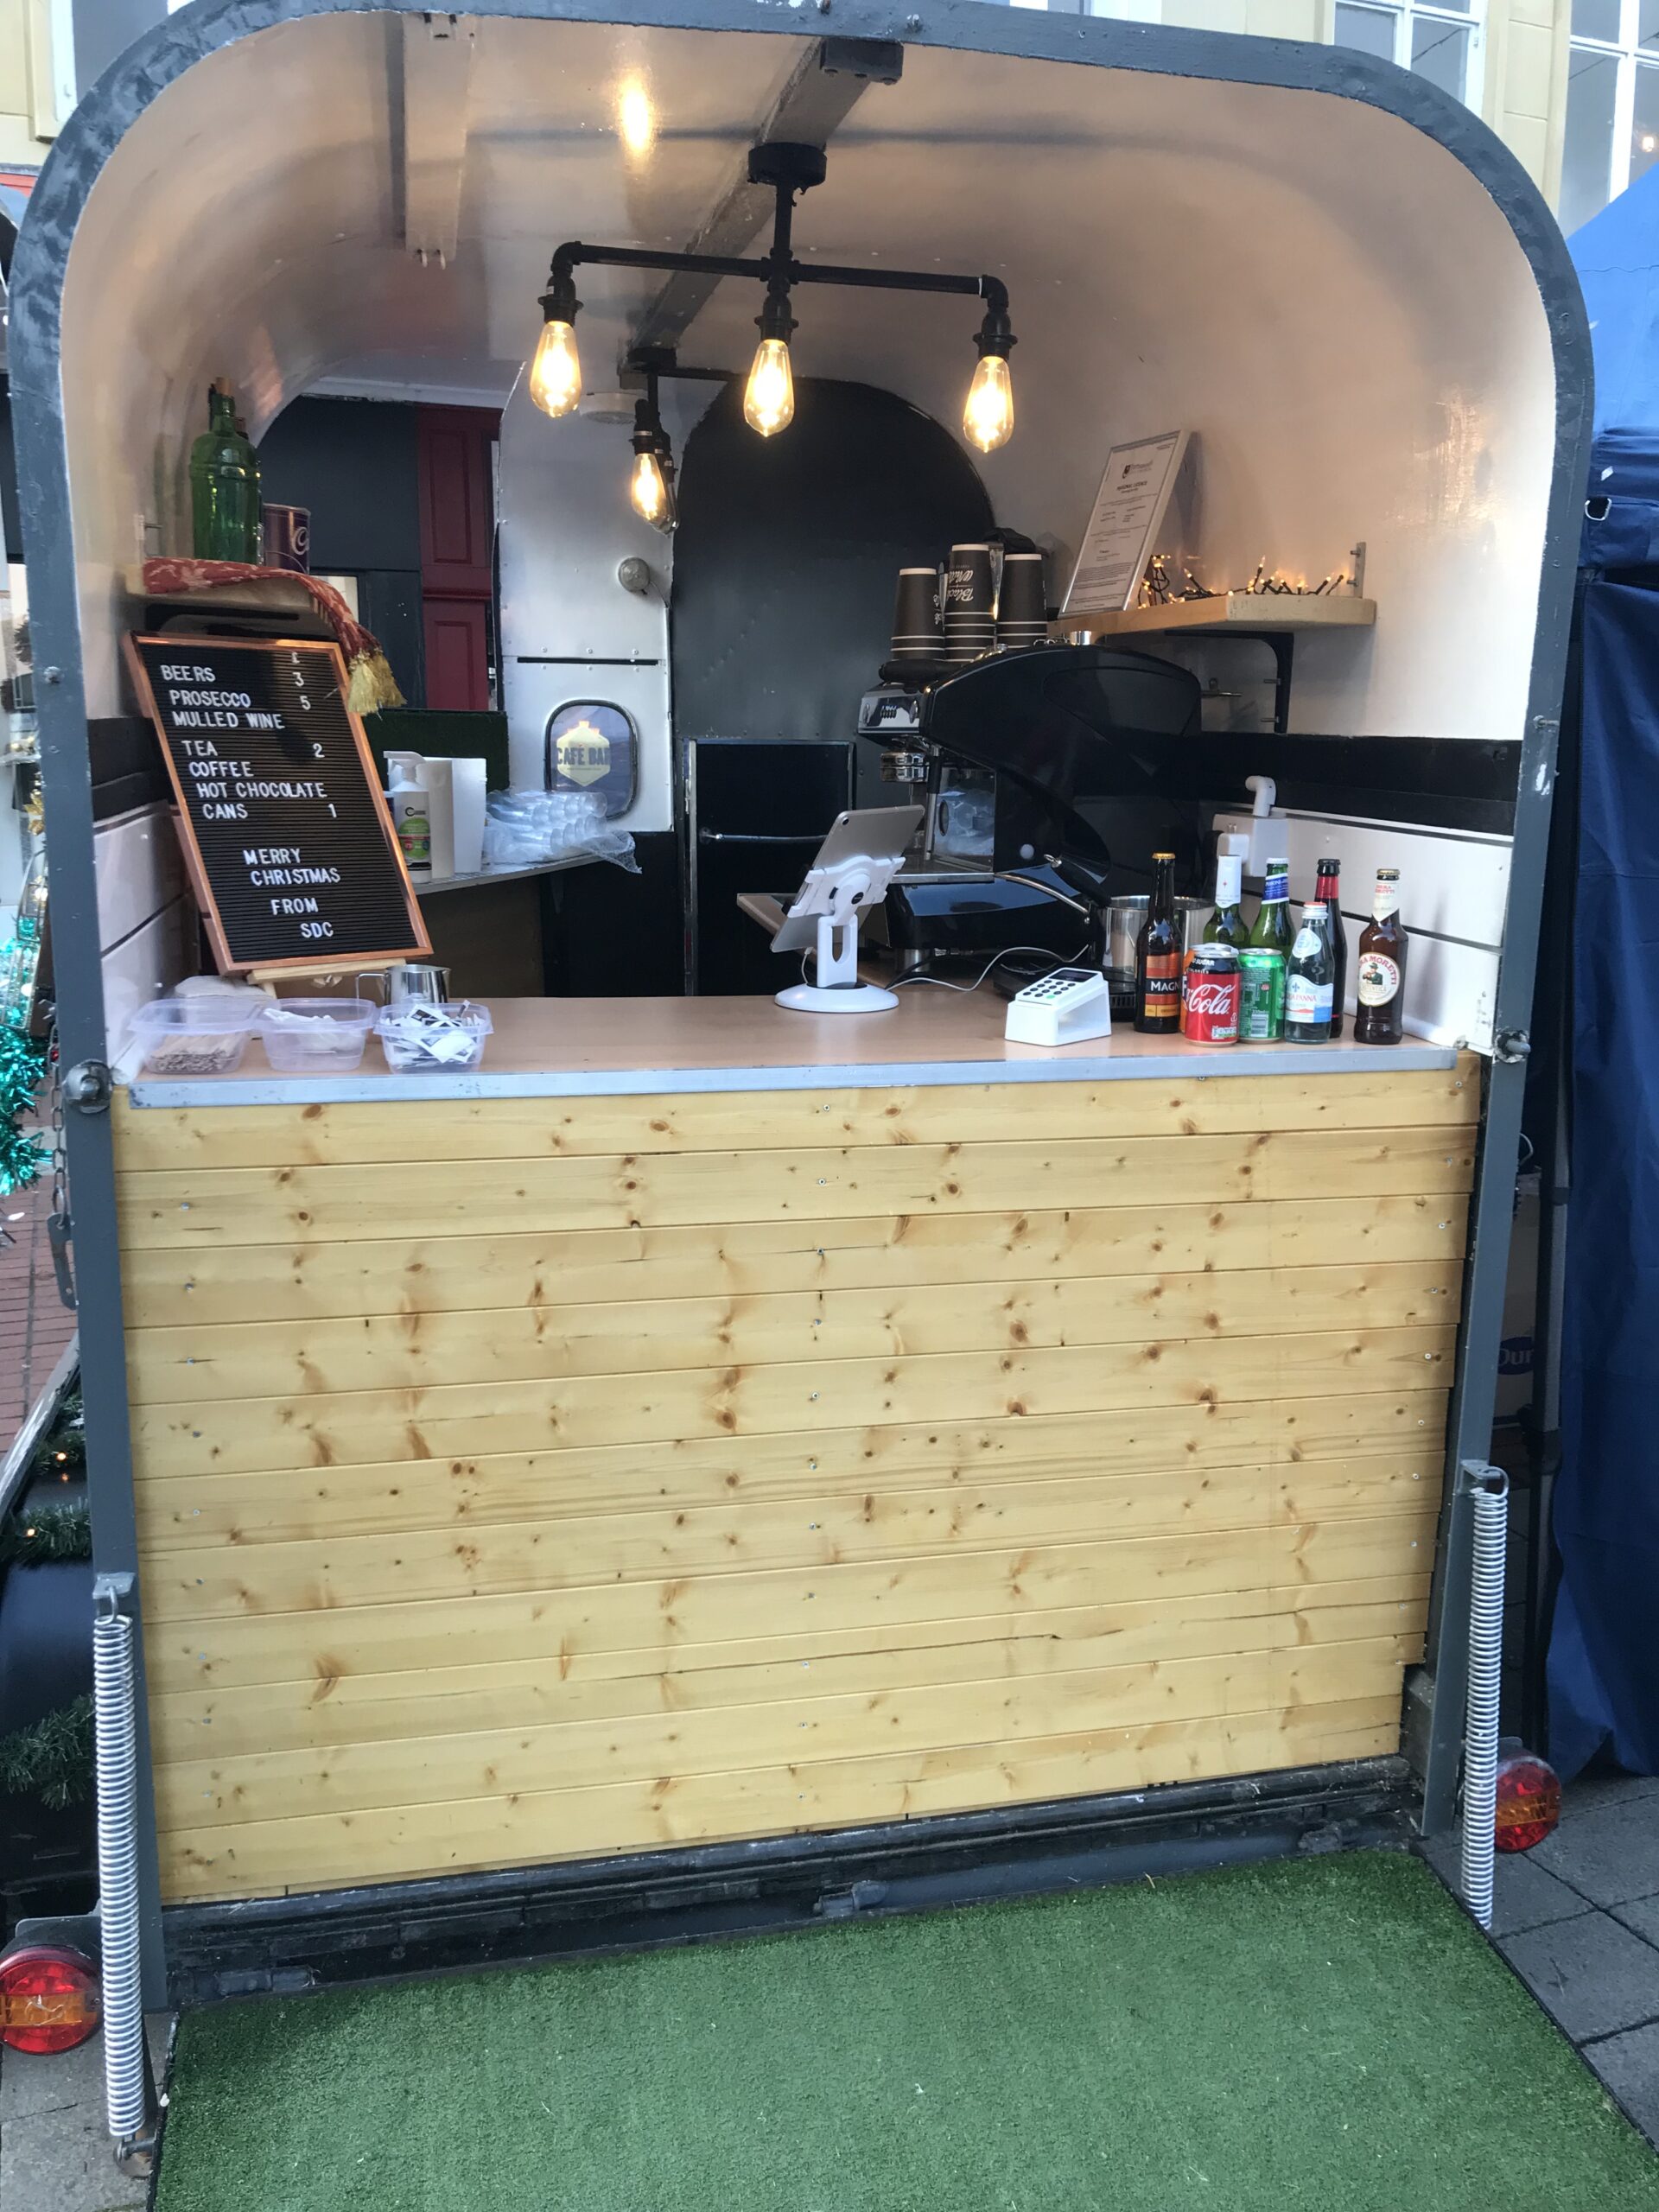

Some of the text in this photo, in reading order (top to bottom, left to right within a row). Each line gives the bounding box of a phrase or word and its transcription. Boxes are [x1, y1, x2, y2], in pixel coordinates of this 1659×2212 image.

[160, 664, 305, 687] BEERS 3
[168, 690, 311, 710] PROSECCO 5
[172, 711, 285, 729] MULLED WINE
[181, 740, 325, 759] TEA 2
[188, 761, 254, 778] COFFEE
[195, 782, 327, 798] HOT CHOCOLATE
[202, 803, 337, 820] CANS 1
[243, 848, 302, 865] MERRY
[251, 868, 340, 887] CHRISTMAS
[270, 897, 319, 916] FROM
[300, 921, 334, 938] SDC
[1369, 955, 1398, 986] MORETTI
[1188, 983, 1236, 1015] Cola
